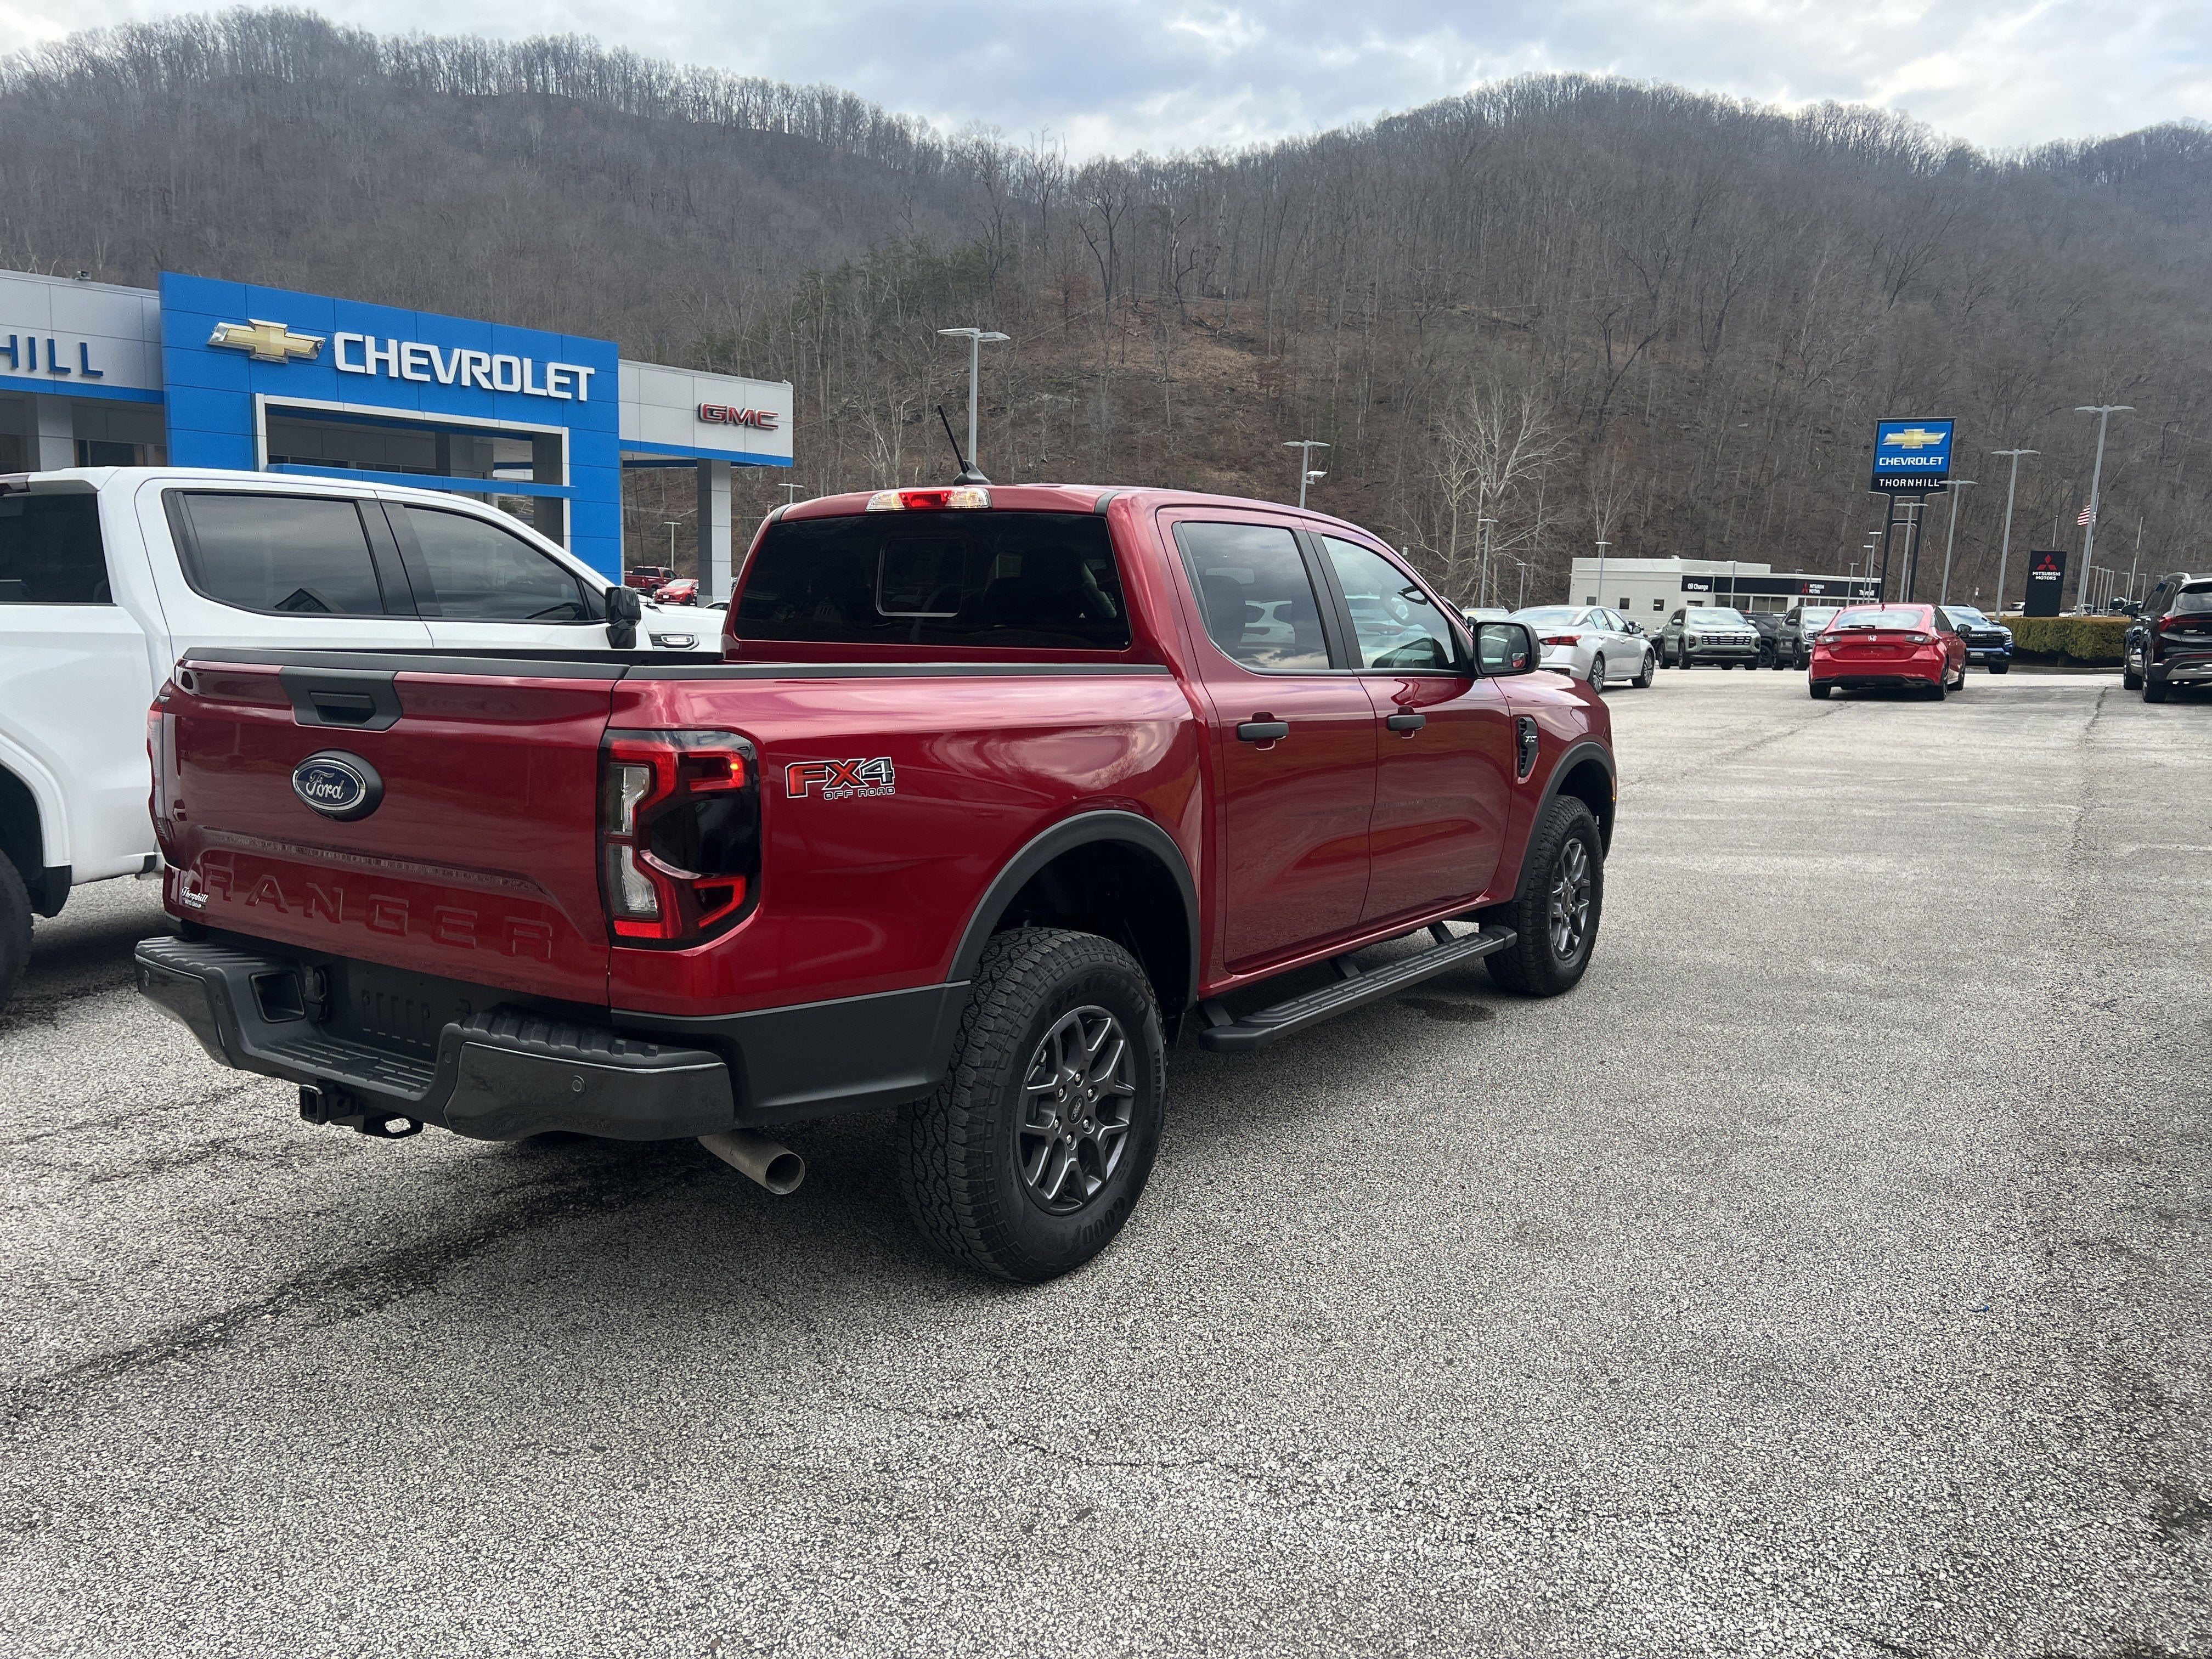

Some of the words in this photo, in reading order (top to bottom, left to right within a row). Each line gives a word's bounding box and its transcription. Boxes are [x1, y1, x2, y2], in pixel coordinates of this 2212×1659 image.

[0, 334, 104, 377] HILL
[334, 331, 595, 401] CHEVROLET
[698, 403, 778, 429] GMC
[1878, 456, 1944, 466] CHEVROLET
[1879, 478, 1940, 487] THORNHILL
[1694, 583, 1708, 591] Change
[305, 769, 345, 799] Ford
[785, 757, 895, 798] FX4
[823, 789, 854, 800] OFF
[857, 786, 895, 797] ROAD
[180, 886, 208, 903] Thornhill
[203, 863, 552, 962] RANGER
